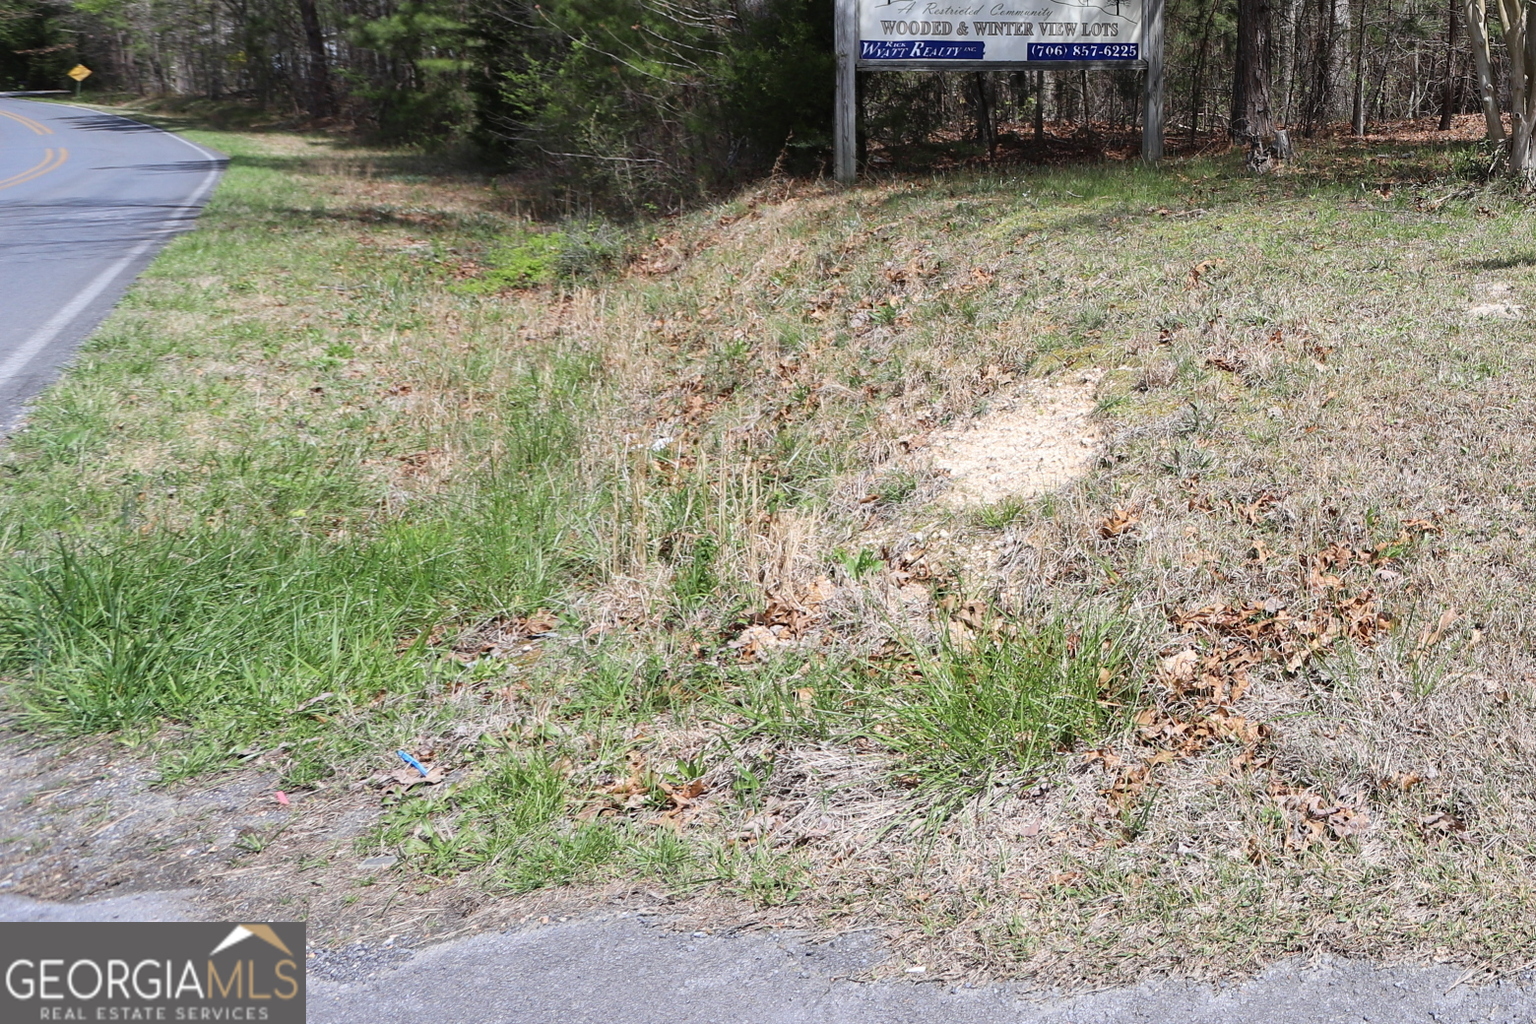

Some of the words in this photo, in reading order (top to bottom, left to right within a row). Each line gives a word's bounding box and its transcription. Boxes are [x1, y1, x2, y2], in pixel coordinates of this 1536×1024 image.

[898, 1, 917, 14] A
[923, 2, 984, 17] Restricted
[990, 2, 1054, 20] Community
[880, 20, 953, 36] WOODED
[956, 21, 969, 36] &
[972, 21, 1034, 37] WINTER
[1038, 21, 1078, 37] VIEW
[1081, 22, 1119, 37] LOTS
[1031, 44, 1068, 58] (706)
[1072, 45, 1137, 57] 857-6225
